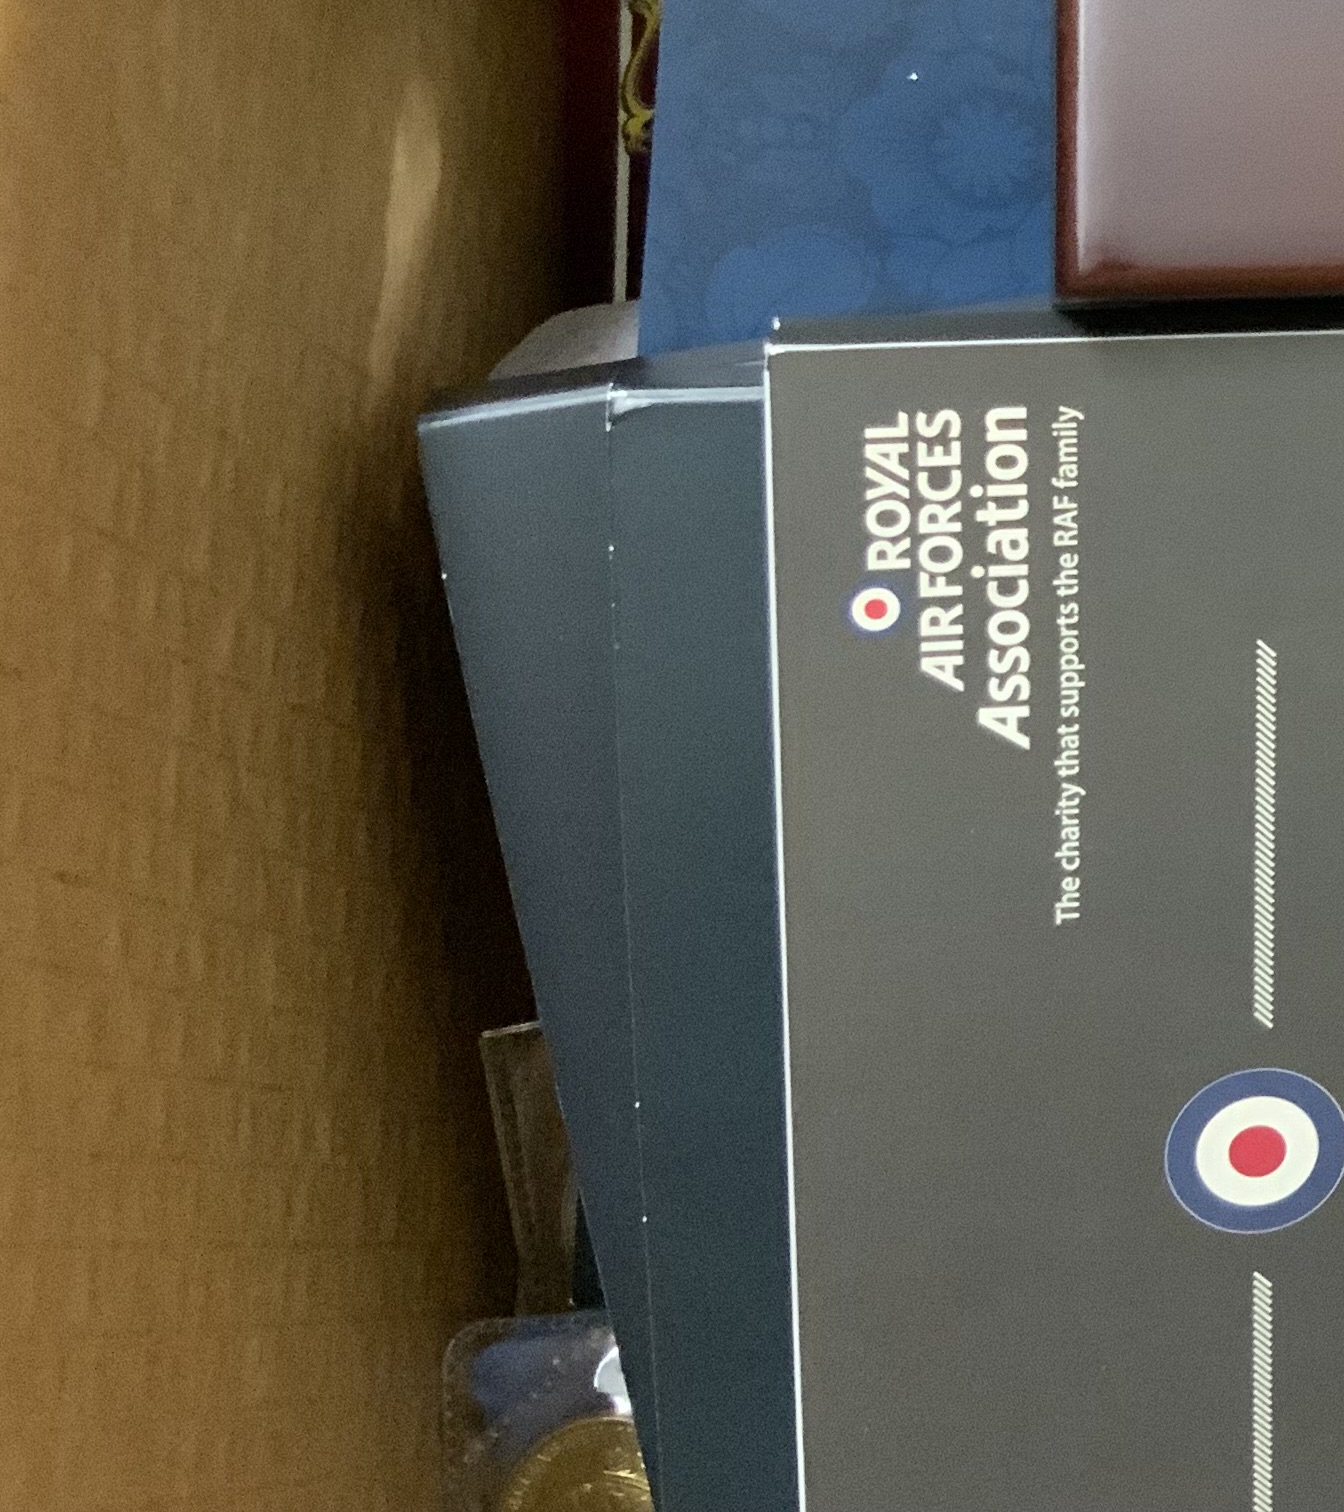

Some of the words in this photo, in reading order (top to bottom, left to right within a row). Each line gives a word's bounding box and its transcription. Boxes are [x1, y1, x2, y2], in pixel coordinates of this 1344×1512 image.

[1050, 404, 1086, 489] family
[863, 410, 912, 572] ROYAL
[915, 407, 964, 599] FORCES
[1052, 495, 1080, 550] RAF
[969, 404, 1031, 750] Association
[1052, 554, 1080, 599] the
[918, 603, 965, 692] AIR
[1052, 602, 1086, 717] supports
[1053, 722, 1080, 778] that
[1053, 784, 1086, 872] charity
[1055, 878, 1081, 926] The
